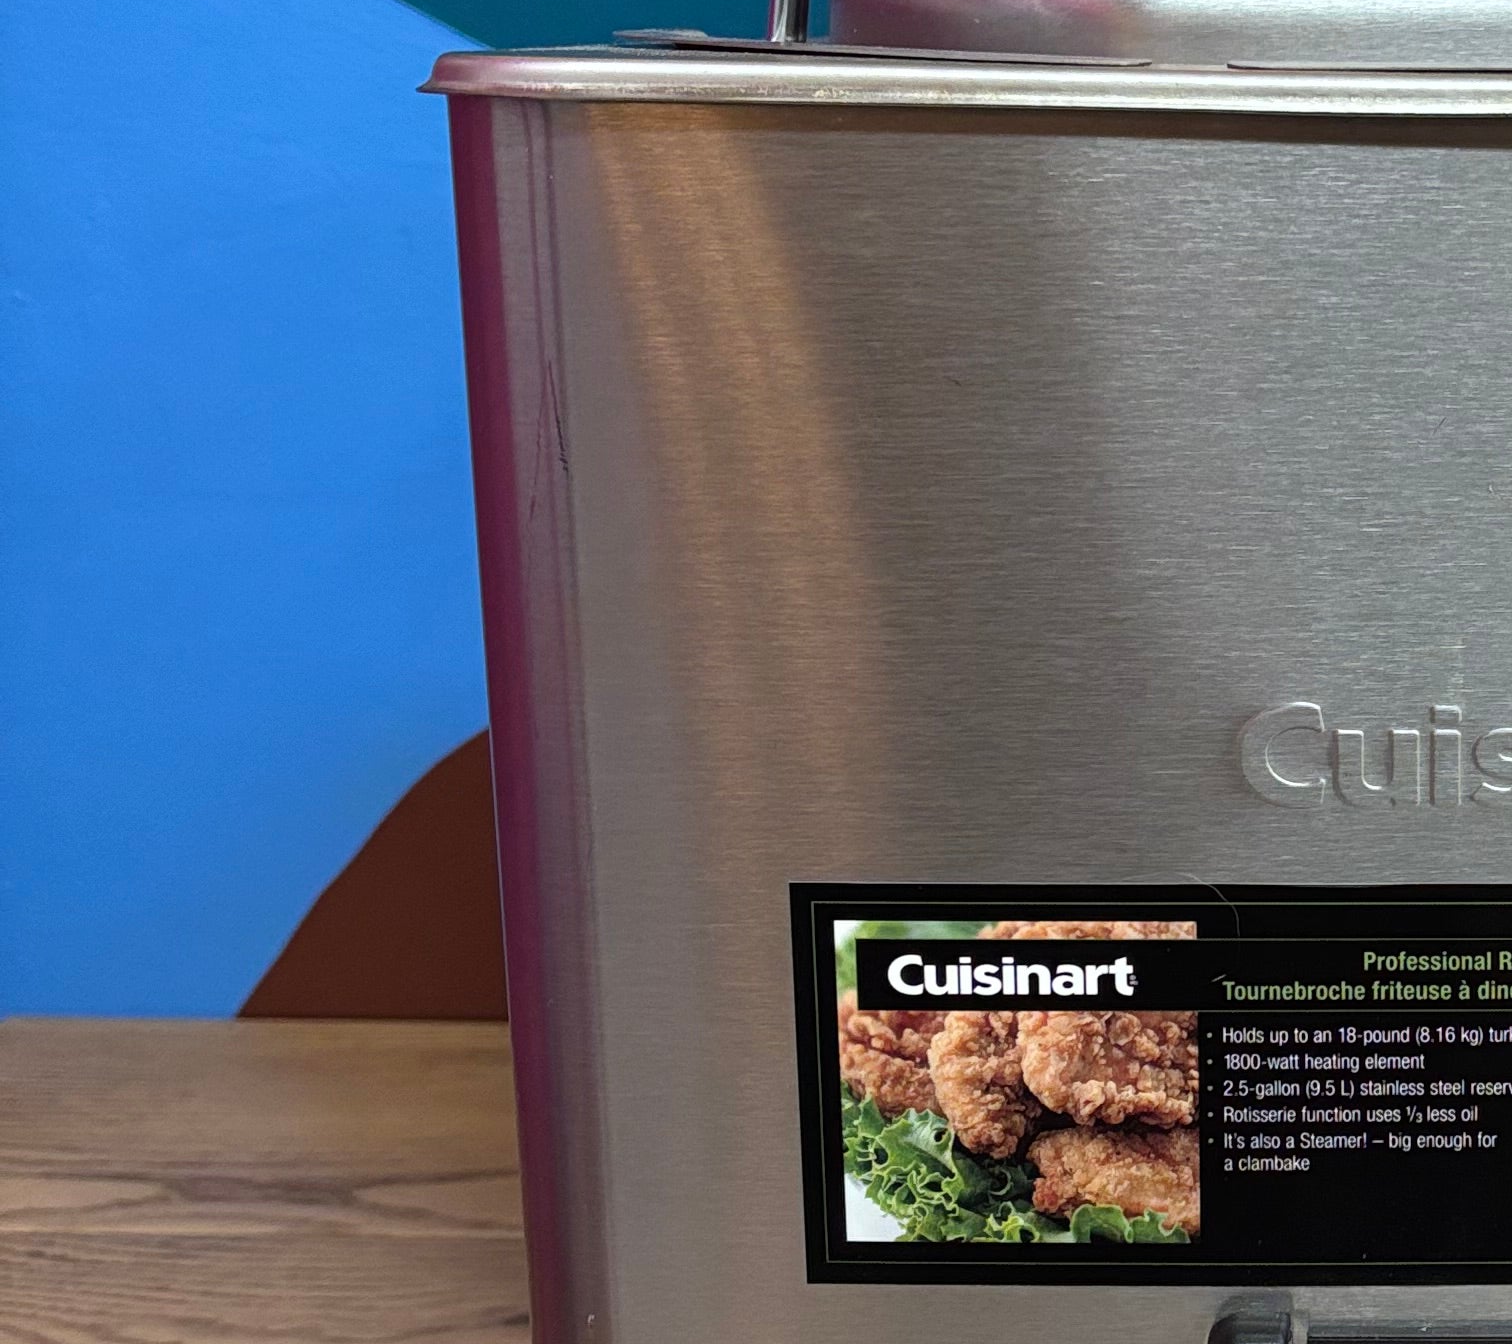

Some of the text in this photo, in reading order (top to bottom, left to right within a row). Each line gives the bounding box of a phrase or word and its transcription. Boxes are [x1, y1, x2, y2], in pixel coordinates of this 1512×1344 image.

[1363, 950, 1492, 972] Professional
[887, 954, 1136, 997] Cuisinart
[1222, 980, 1366, 1001] Tournebroche
[1371, 980, 1452, 1001] friteuse
[1458, 979, 1471, 1001] à
[1222, 1026, 1265, 1044] Holds
[1269, 1030, 1289, 1047] up
[1293, 1027, 1309, 1044] to
[1312, 1029, 1333, 1044] an
[1338, 1026, 1411, 1047] 18-pound
[1415, 1026, 1456, 1047] (8.16
[1460, 1026, 1484, 1047] kg)
[1223, 1053, 1425, 1074] 1800-watt heating element
[1223, 1079, 1301, 1100] 2.5-gallon
[1305, 1079, 1336, 1099] (9.5
[1340, 1079, 1355, 1099] L)
[1359, 1079, 1425, 1097] stainless
[1429, 1079, 1465, 1096] steel
[1223, 1105, 1297, 1123] Rotisserie
[1301, 1105, 1361, 1123] function
[1366, 1108, 1402, 1123] uses
[1426, 1105, 1457, 1123] less
[1460, 1105, 1479, 1122] oil
[1249, 1132, 1281, 1150] also
[1285, 1135, 1295, 1149] a
[1299, 1131, 1367, 1149] Steamer!
[1388, 1132, 1412, 1152] big
[1416, 1131, 1473, 1152] enough
[1477, 1131, 1498, 1148] for
[1223, 1154, 1311, 1172] a clambake
